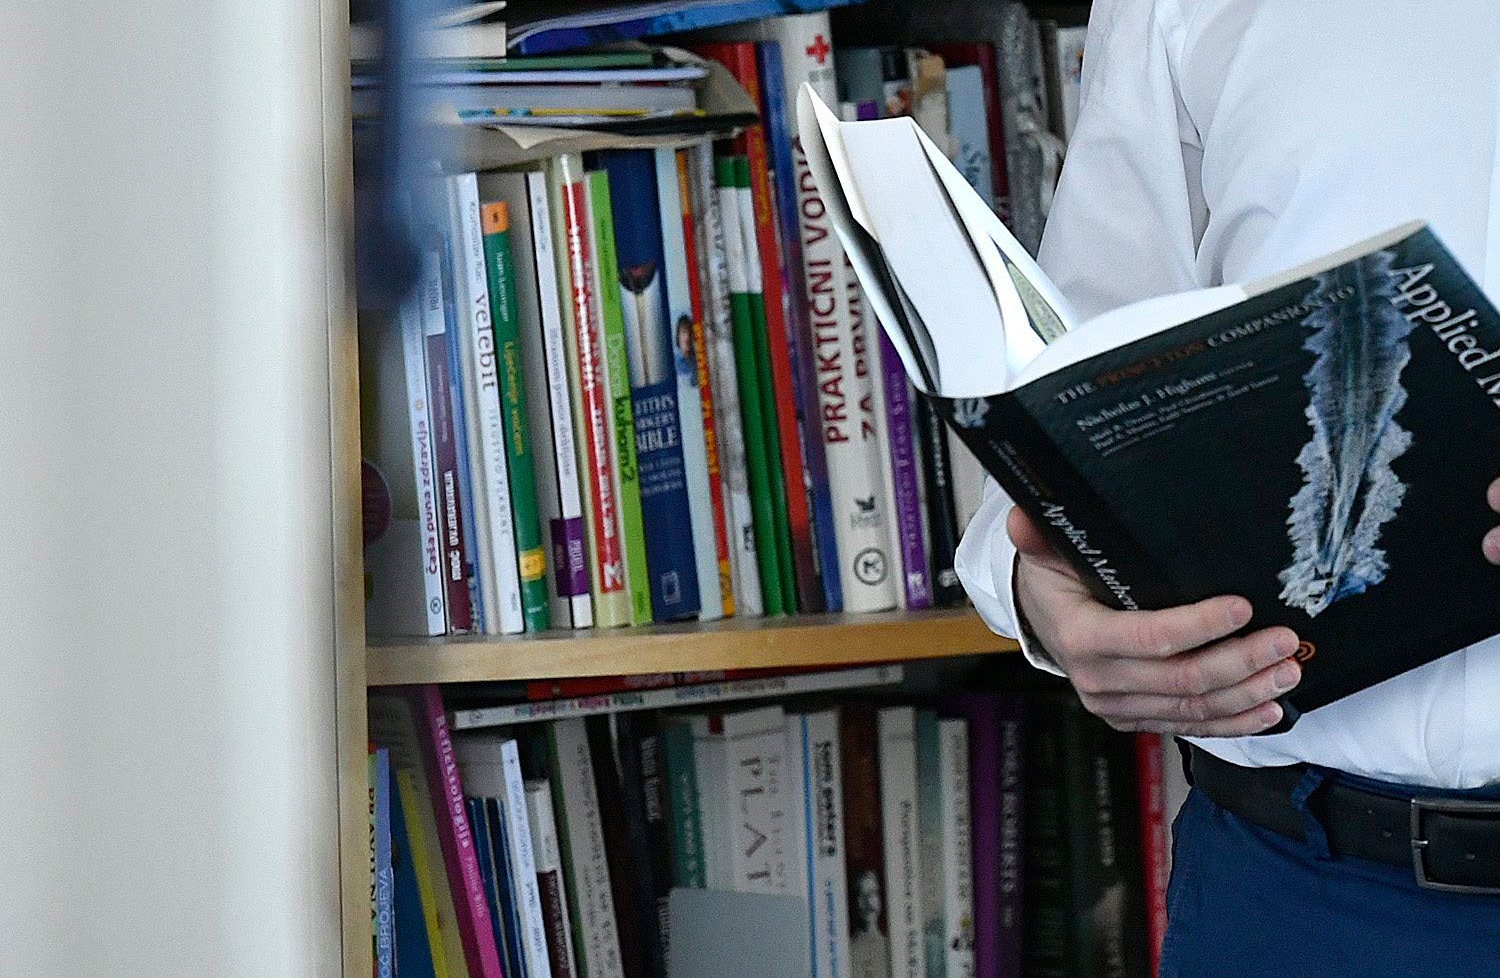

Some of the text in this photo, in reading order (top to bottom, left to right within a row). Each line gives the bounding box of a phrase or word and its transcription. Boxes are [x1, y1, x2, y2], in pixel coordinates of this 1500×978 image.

[471, 291, 500, 391] velebit
[798, 254, 854, 447] PRAKTIČNI
[1053, 378, 1097, 407] THE
[1203, 293, 1325, 351] COMPANION
[856, 394, 878, 443] ZA
[1073, 395, 1142, 433] Nicholas
[1154, 366, 1219, 403] Higham
[411, 417, 441, 577] Čaša puna zdravlja
[1040, 500, 1102, 555] Applied
[427, 711, 476, 850] Reflektologija
[377, 866, 393, 949] BROJEVA
